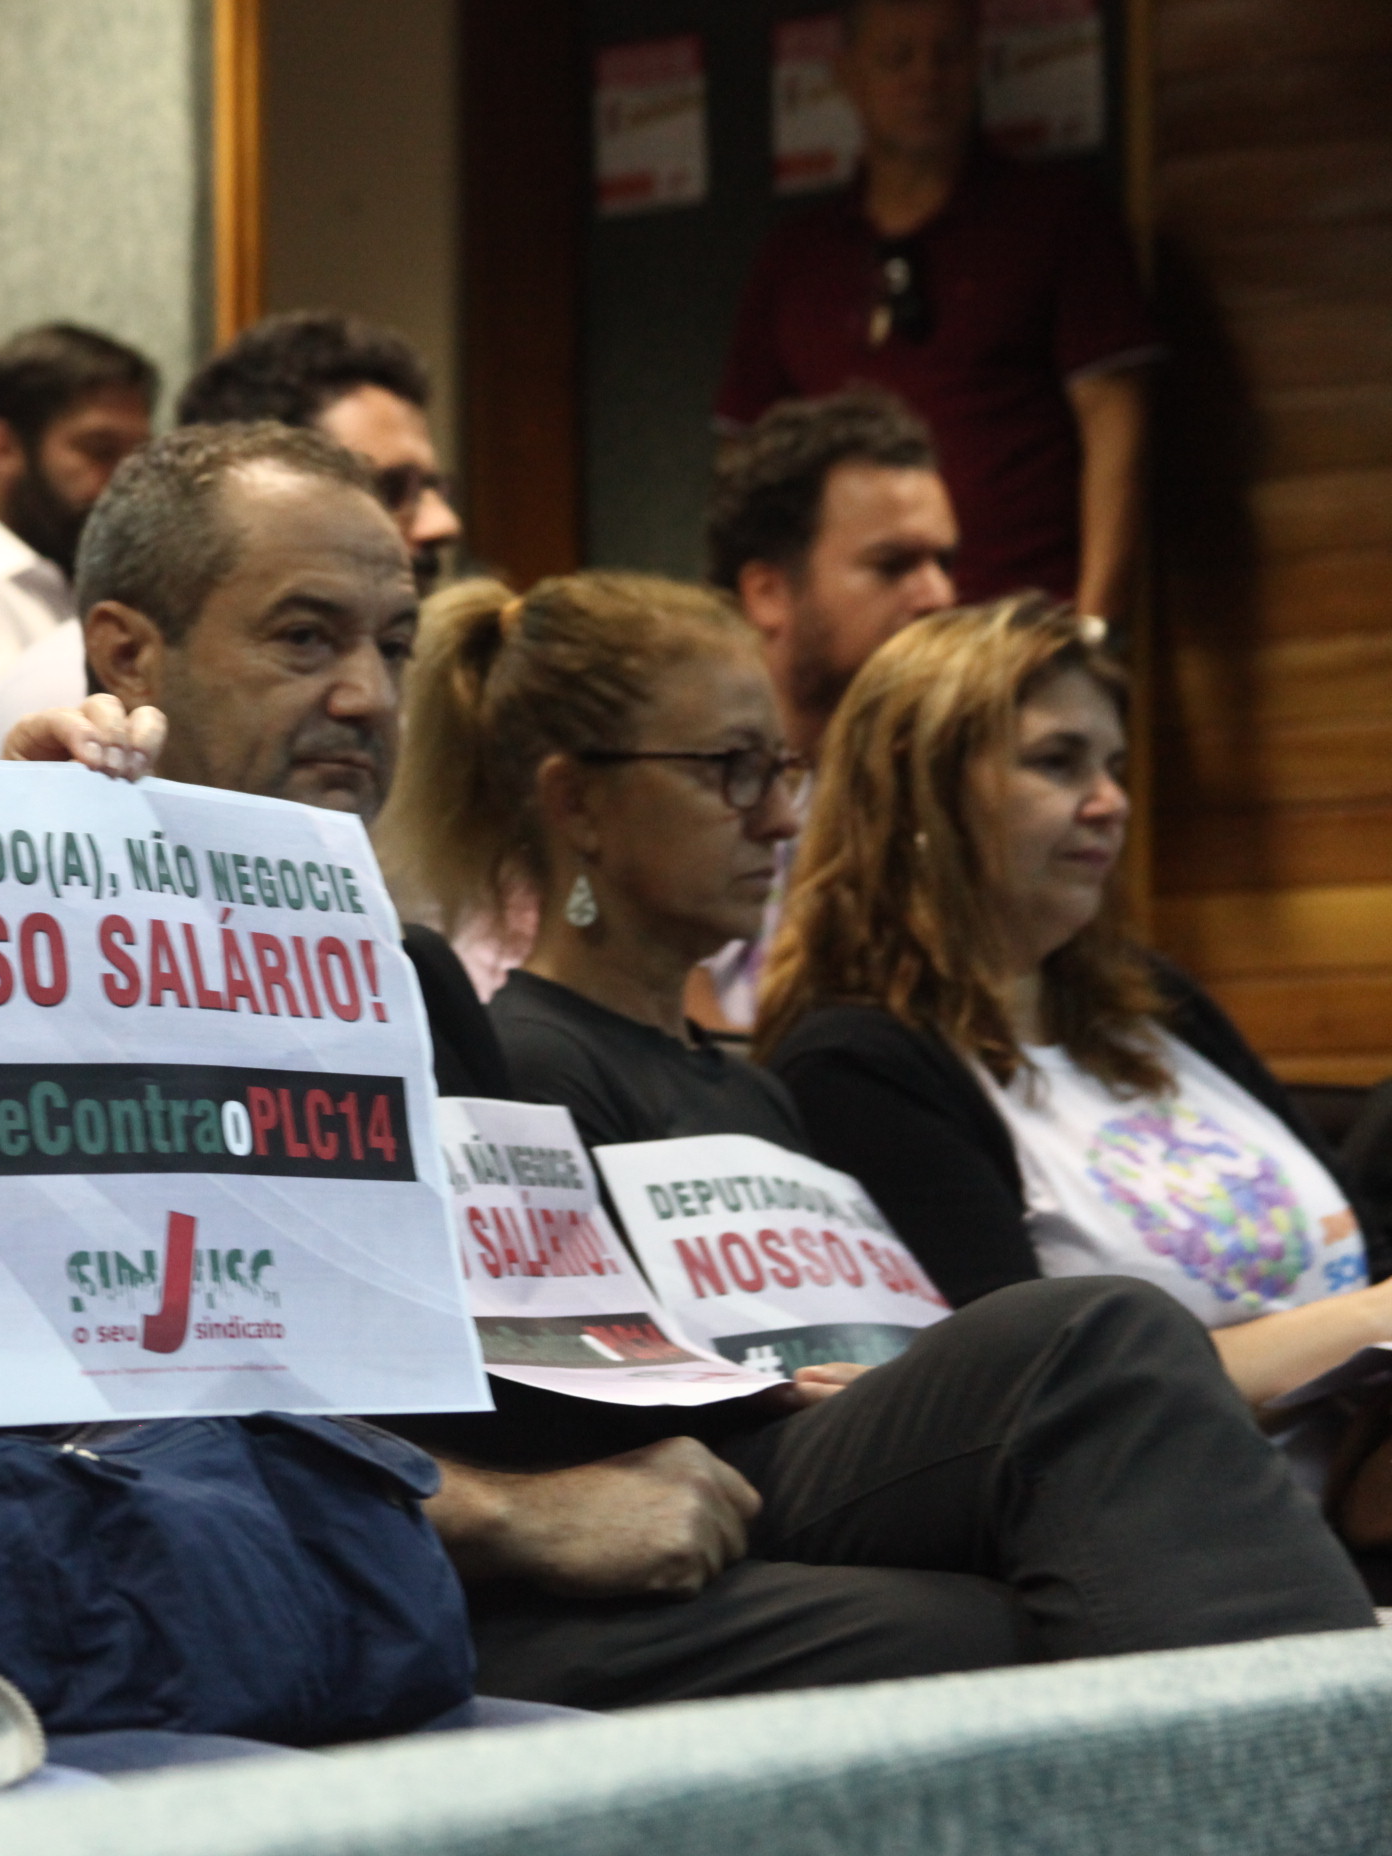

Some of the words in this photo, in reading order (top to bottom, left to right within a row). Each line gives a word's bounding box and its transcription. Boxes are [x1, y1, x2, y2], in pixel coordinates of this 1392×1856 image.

[126, 831, 201, 898] NÃO
[206, 848, 366, 914] NEGOCIE
[99, 908, 390, 1023] SALÁRIO!
[673, 1227, 864, 1299] NOSSO
[72, 1326, 90, 1343] o
[95, 1325, 139, 1342] seu
[193, 1315, 286, 1340] sindicato
